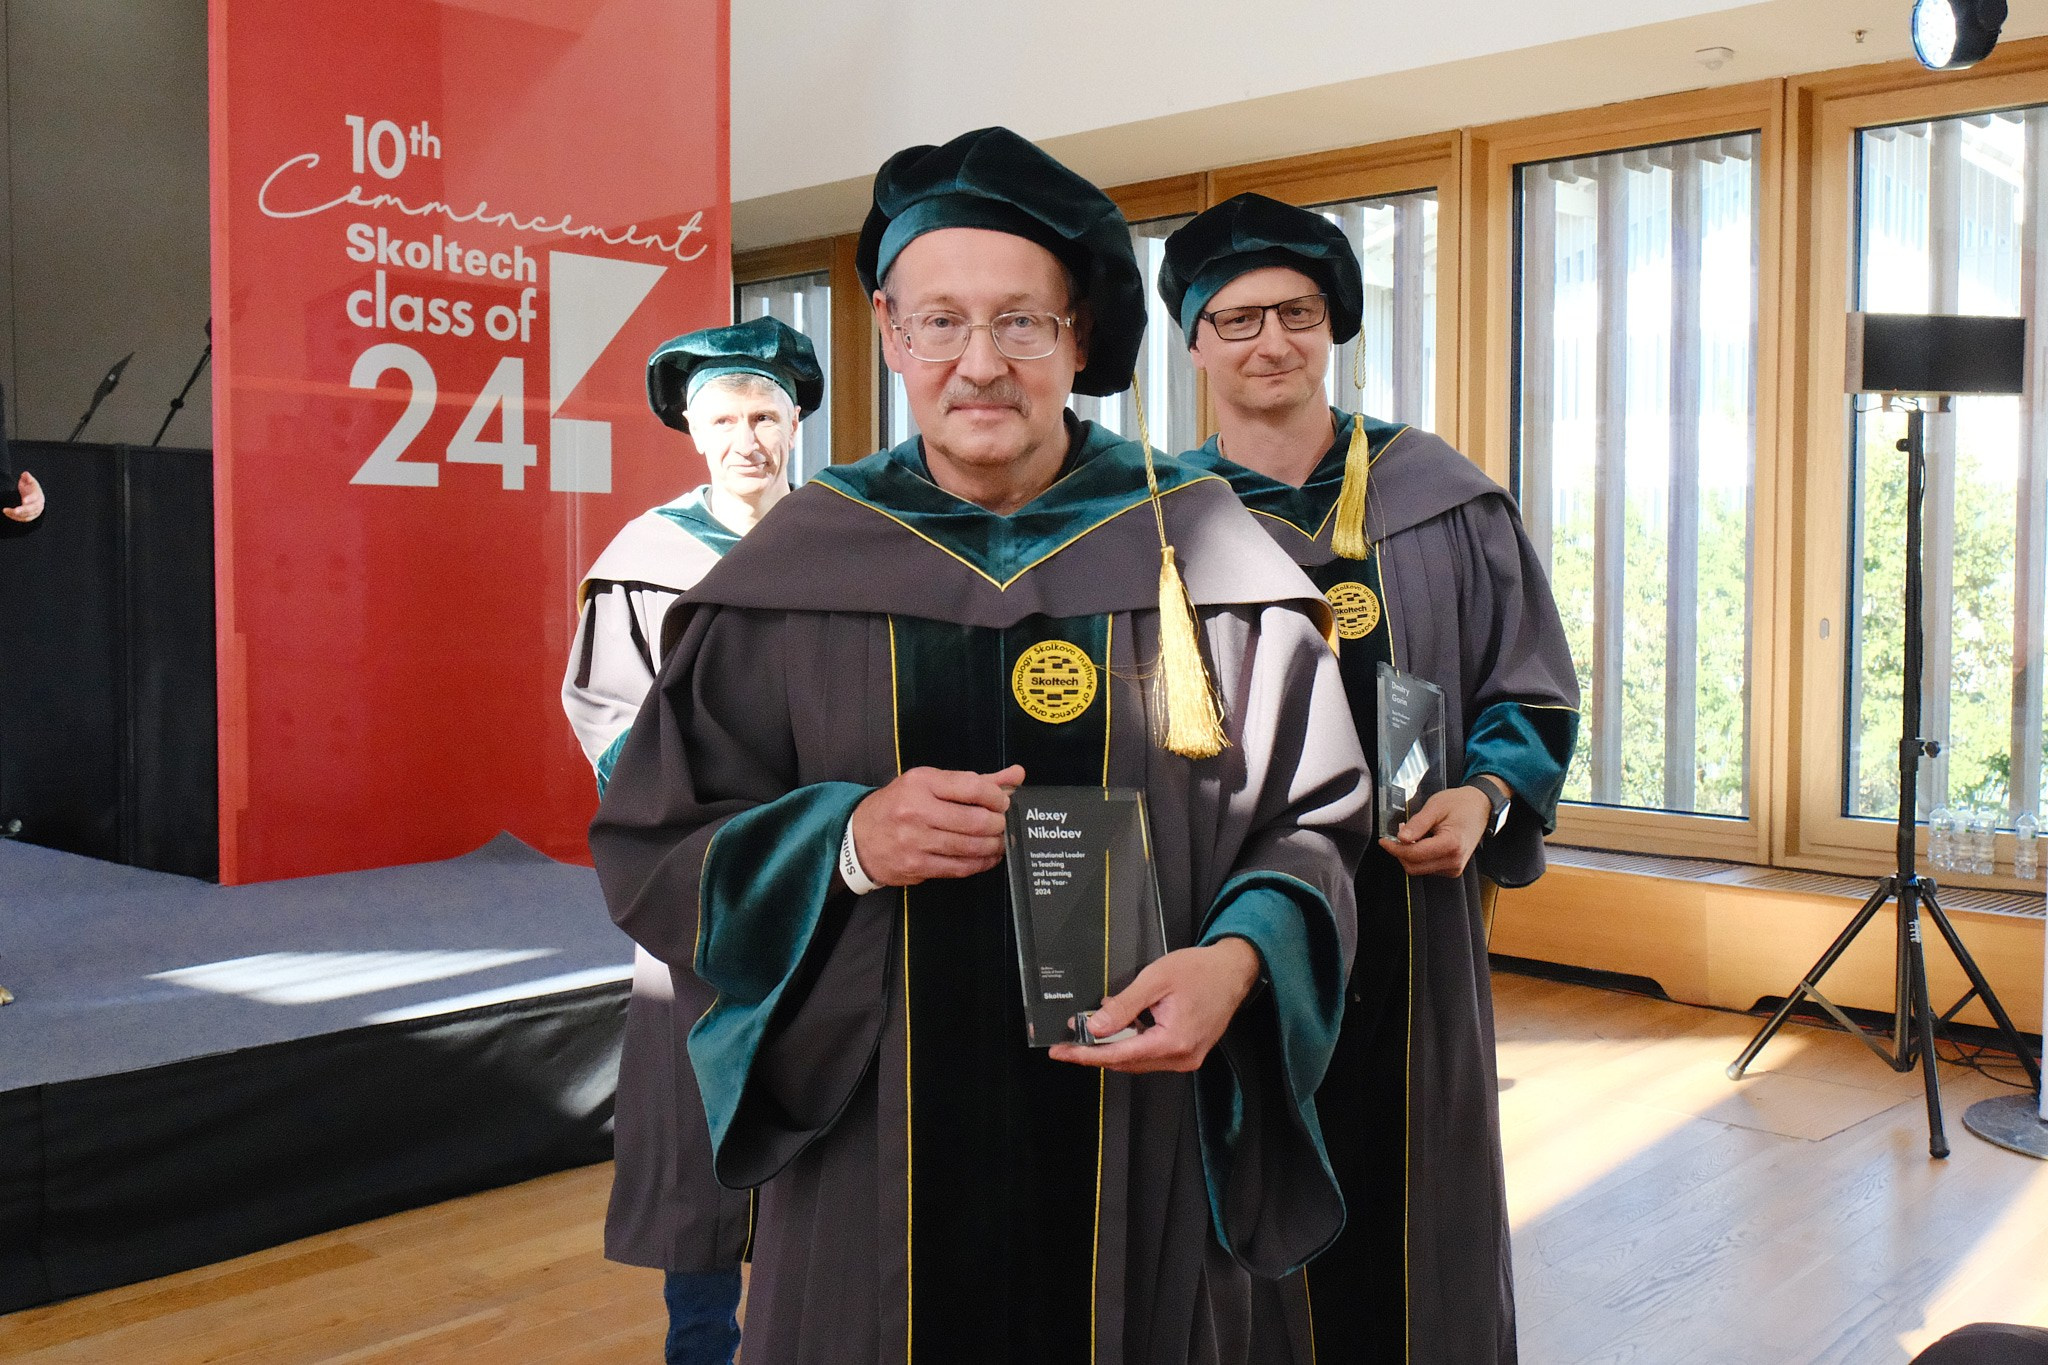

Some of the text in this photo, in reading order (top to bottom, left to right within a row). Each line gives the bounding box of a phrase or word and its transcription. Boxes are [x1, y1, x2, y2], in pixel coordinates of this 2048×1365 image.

[345, 114, 441, 179] 10th
[258, 153, 708, 261] Commencement
[346, 223, 537, 282] Skoltech
[346, 270, 537, 343] class of
[349, 343, 538, 491] 24
[1335, 605, 1367, 615] Skoltech
[1017, 643, 1093, 719] Skolkovo Institute of Science and Technology
[1031, 677, 1079, 686] Skoltech
[1026, 807, 1068, 824] Alexey
[1027, 825, 1082, 839] Nikolaev
[843, 832, 856, 876] Skolte
[1030, 851, 1064, 859] Institutional
[1038, 860, 1065, 869] Teaching
[1045, 870, 1072, 878] Learning
[1034, 888, 1052, 896] 2024
